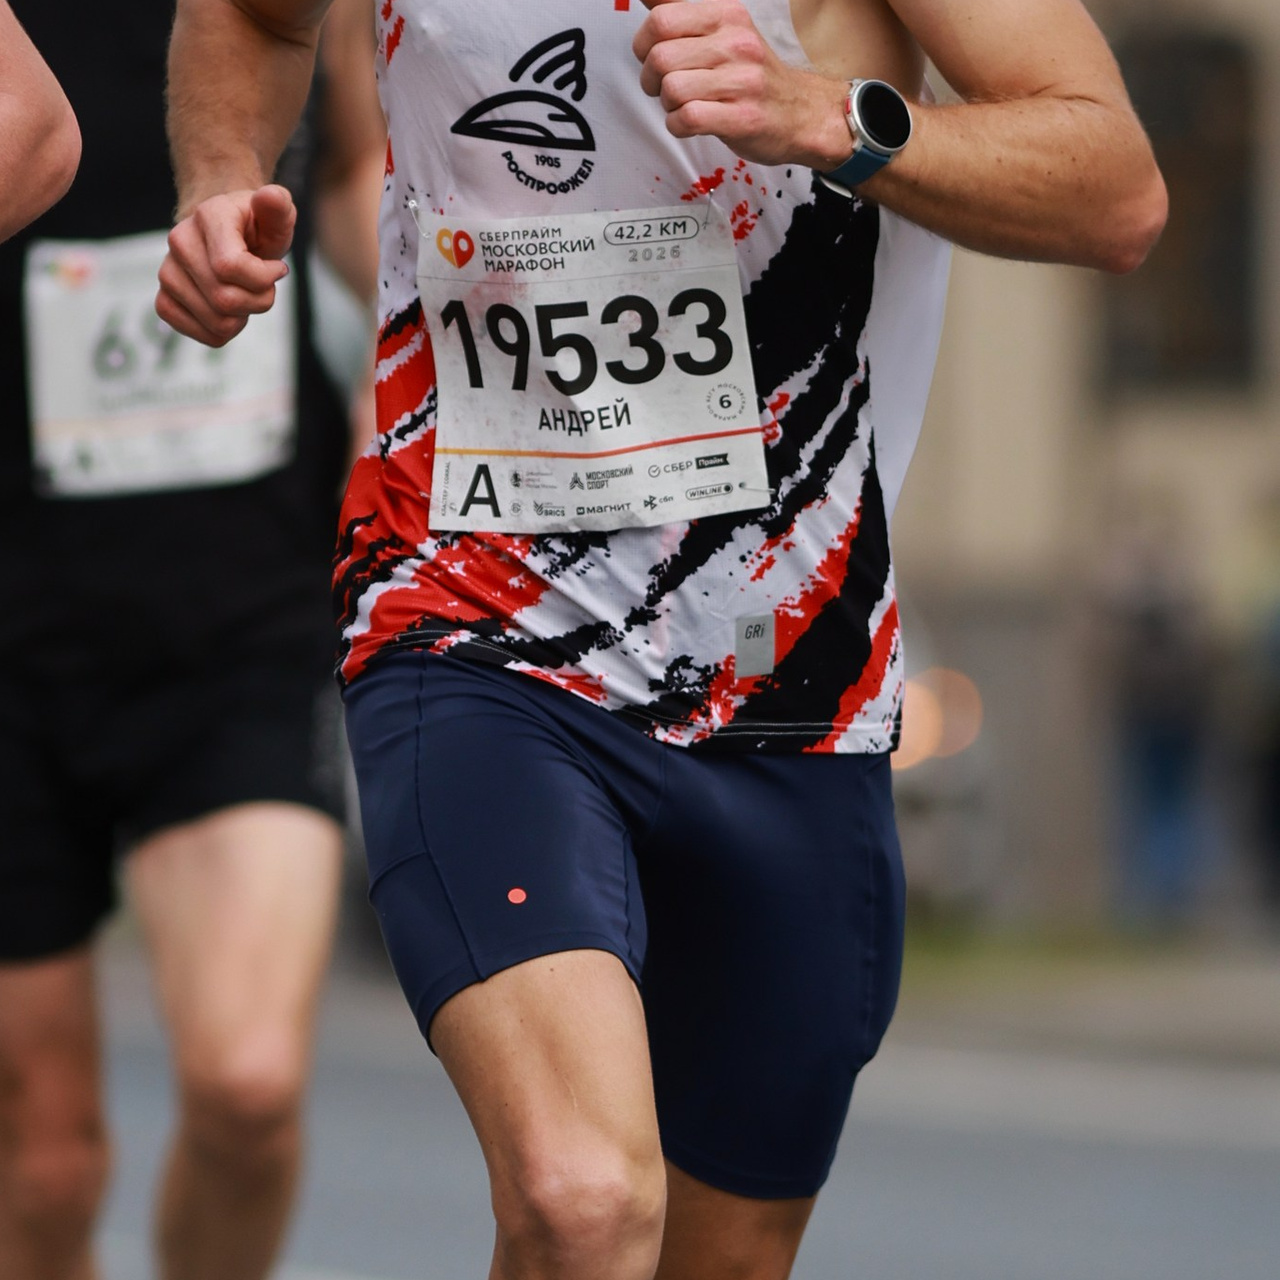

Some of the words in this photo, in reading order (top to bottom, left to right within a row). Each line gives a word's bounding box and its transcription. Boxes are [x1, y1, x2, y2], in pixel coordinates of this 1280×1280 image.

[535, 154, 561, 168] 1905
[501, 150, 595, 195] РОСПРОФЖЕЛ
[479, 227, 562, 242] СБЕРПРАЙМ
[614, 224, 652, 240] 42,2
[660, 221, 687, 236] КМ
[482, 237, 595, 258] МОСКОВСКИЙ
[484, 257, 565, 272] МАРАФОН
[440, 288, 733, 396] 19533
[719, 394, 732, 409] 6
[538, 398, 632, 436] АНДРЕЙ
[585, 466, 634, 480] МОСКОВСКИЙ
[663, 461, 693, 474] СБЕР
[586, 480, 609, 490] СПОРТ
[689, 487, 722, 498] WINLINE
[543, 509, 565, 517] BRICS
[745, 623, 765, 639] GRi
